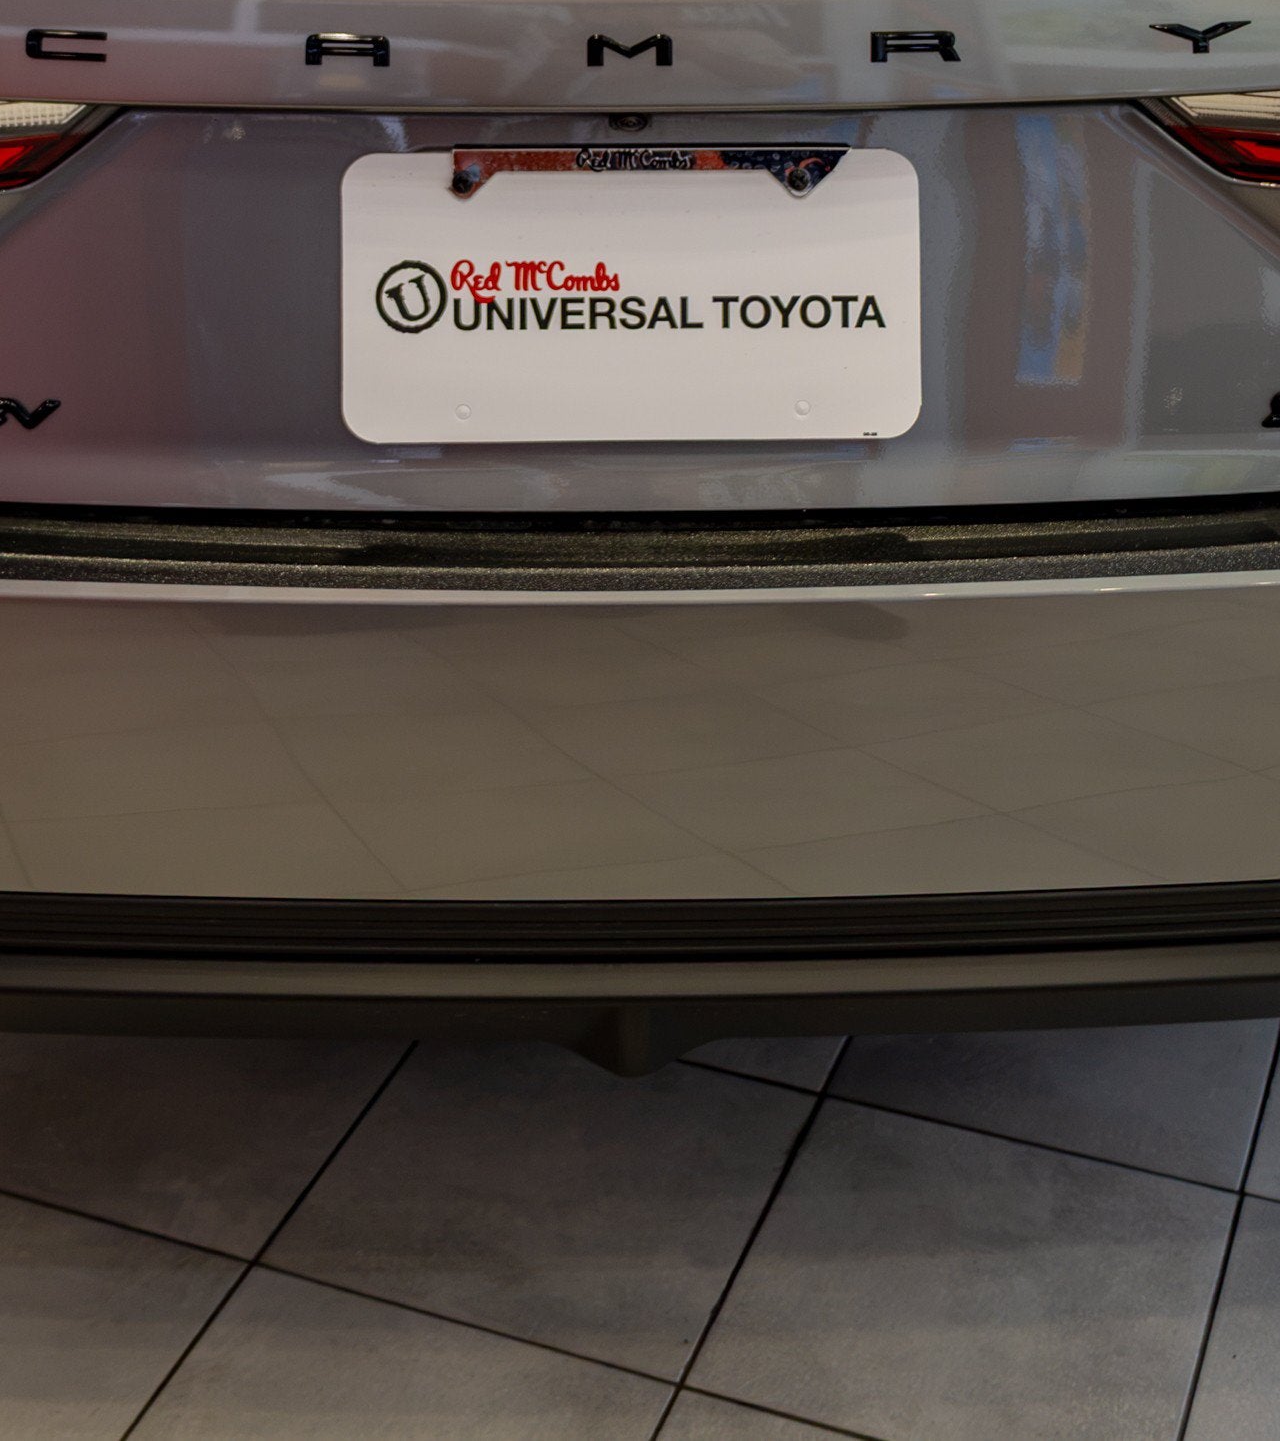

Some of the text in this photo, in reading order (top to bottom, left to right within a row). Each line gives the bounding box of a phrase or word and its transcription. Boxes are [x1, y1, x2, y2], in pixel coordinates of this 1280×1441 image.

[25, 19, 1252, 68] CAMRY
[450, 259, 620, 304] Red McCombs
[453, 294, 887, 331] UNIVERSAL TOYOTA
